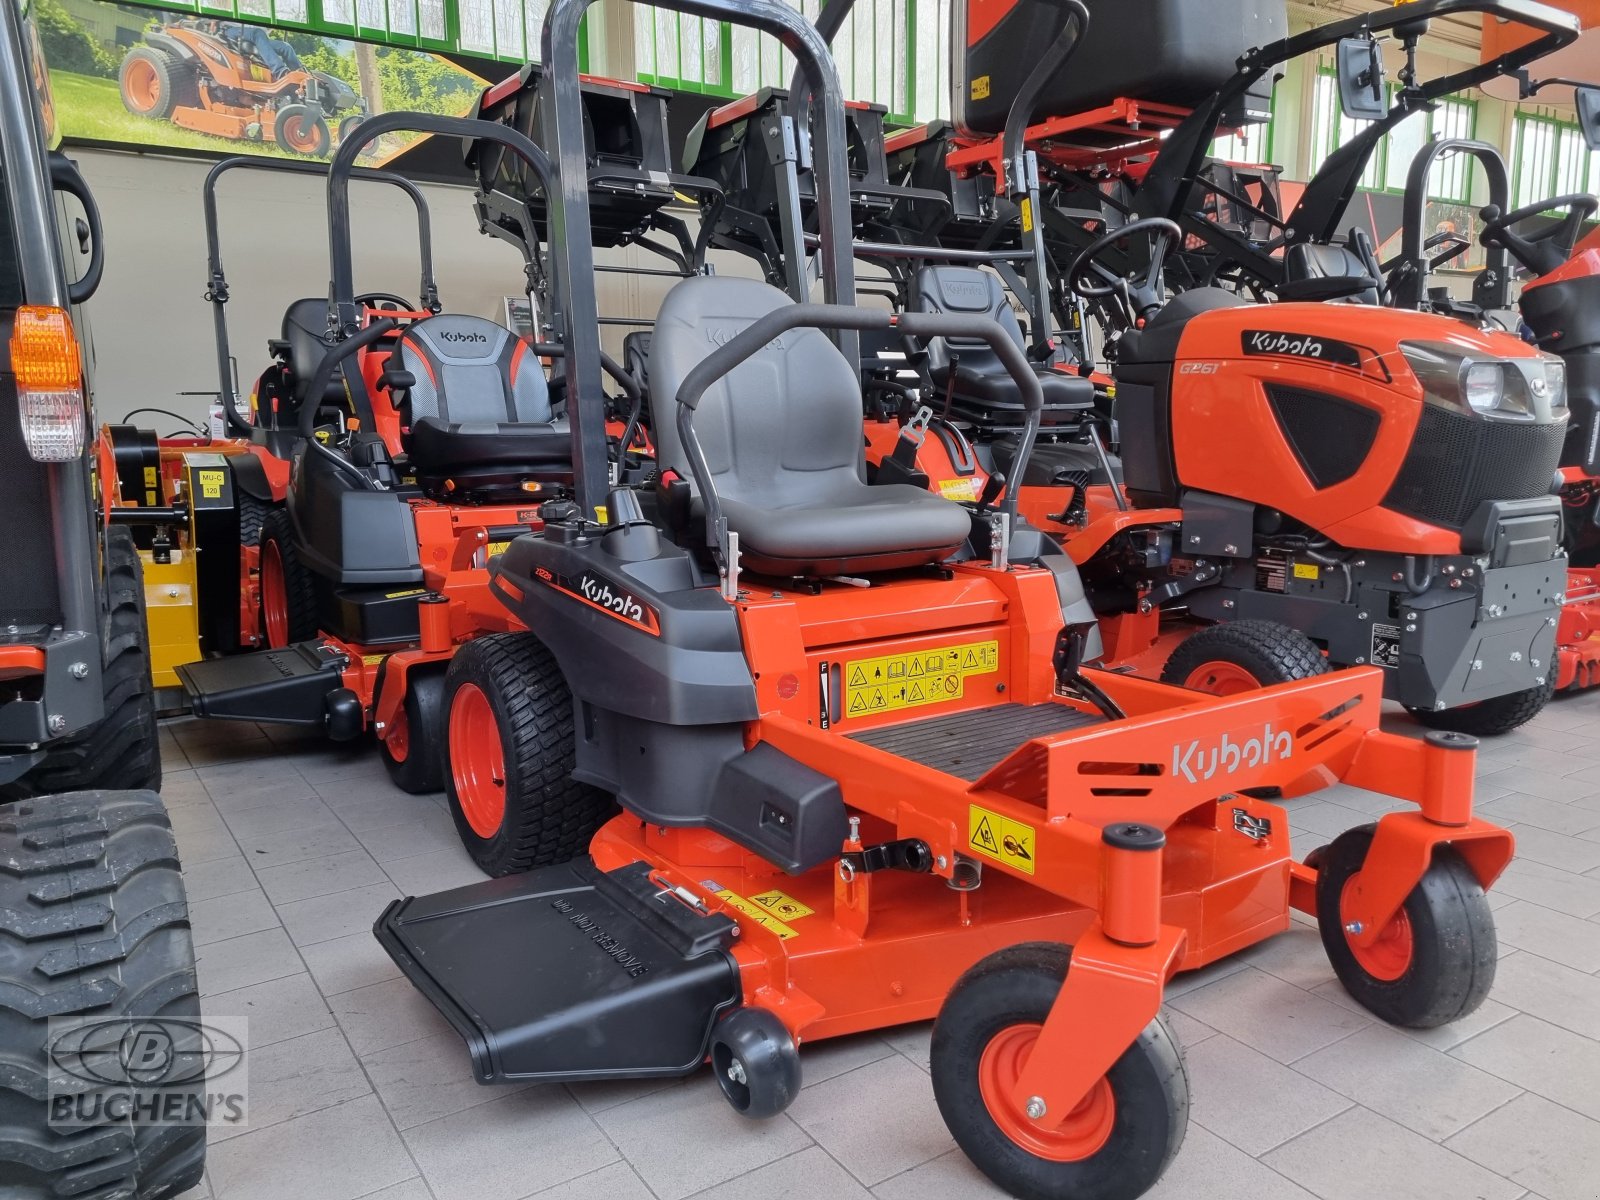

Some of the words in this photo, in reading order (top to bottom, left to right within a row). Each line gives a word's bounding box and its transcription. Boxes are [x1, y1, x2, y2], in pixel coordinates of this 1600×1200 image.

[440, 331, 487, 343] Kubota
[1250, 331, 1323, 358] Kubota
[1179, 362, 1220, 375] G261
[520, 511, 538, 519] K-R
[580, 575, 643, 622] Kubota
[821, 663, 828, 672] F
[822, 720, 829, 729] E
[1172, 723, 1292, 784] Kubota
[569, 913, 601, 934] NOT
[592, 932, 649, 978] REMOVE
